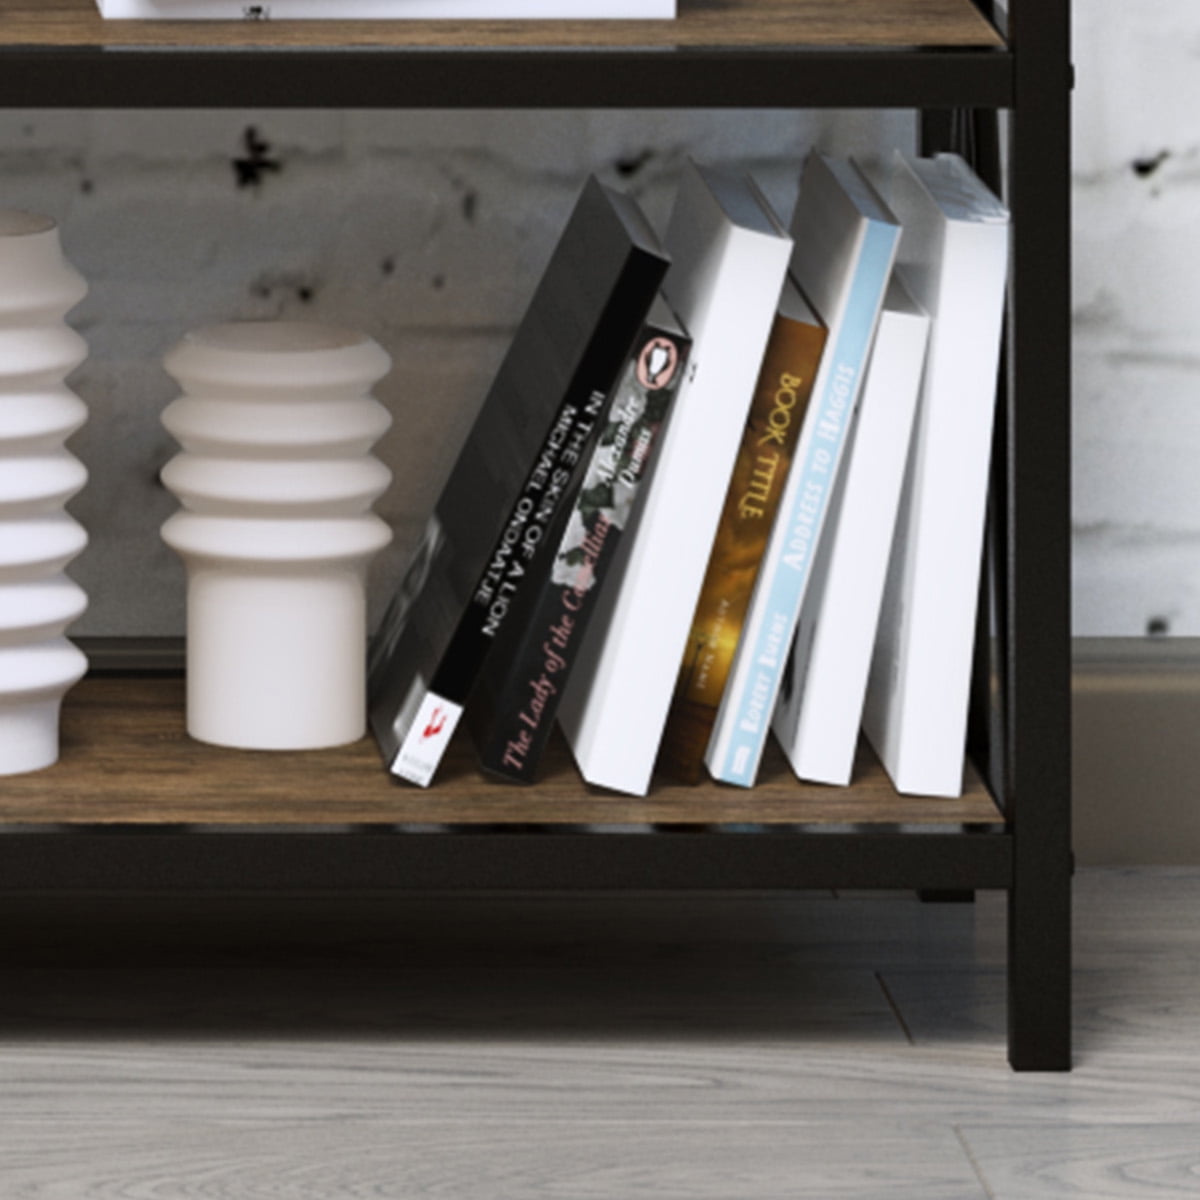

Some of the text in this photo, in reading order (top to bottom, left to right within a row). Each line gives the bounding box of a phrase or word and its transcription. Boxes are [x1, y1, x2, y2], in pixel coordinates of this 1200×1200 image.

[597, 398, 640, 485] Alexandre
[617, 428, 655, 487] Dumas
[740, 373, 802, 519] BOOK TITLE
[784, 363, 854, 569] ADDRESS TO HAGGIS
[476, 405, 576, 605] MICHAEL ONDAATJE
[483, 390, 604, 638] IN THE SKIN OF A LION
[537, 643, 568, 674] of
[547, 614, 575, 647] the
[518, 674, 557, 728] Lady
[502, 729, 534, 770] The
